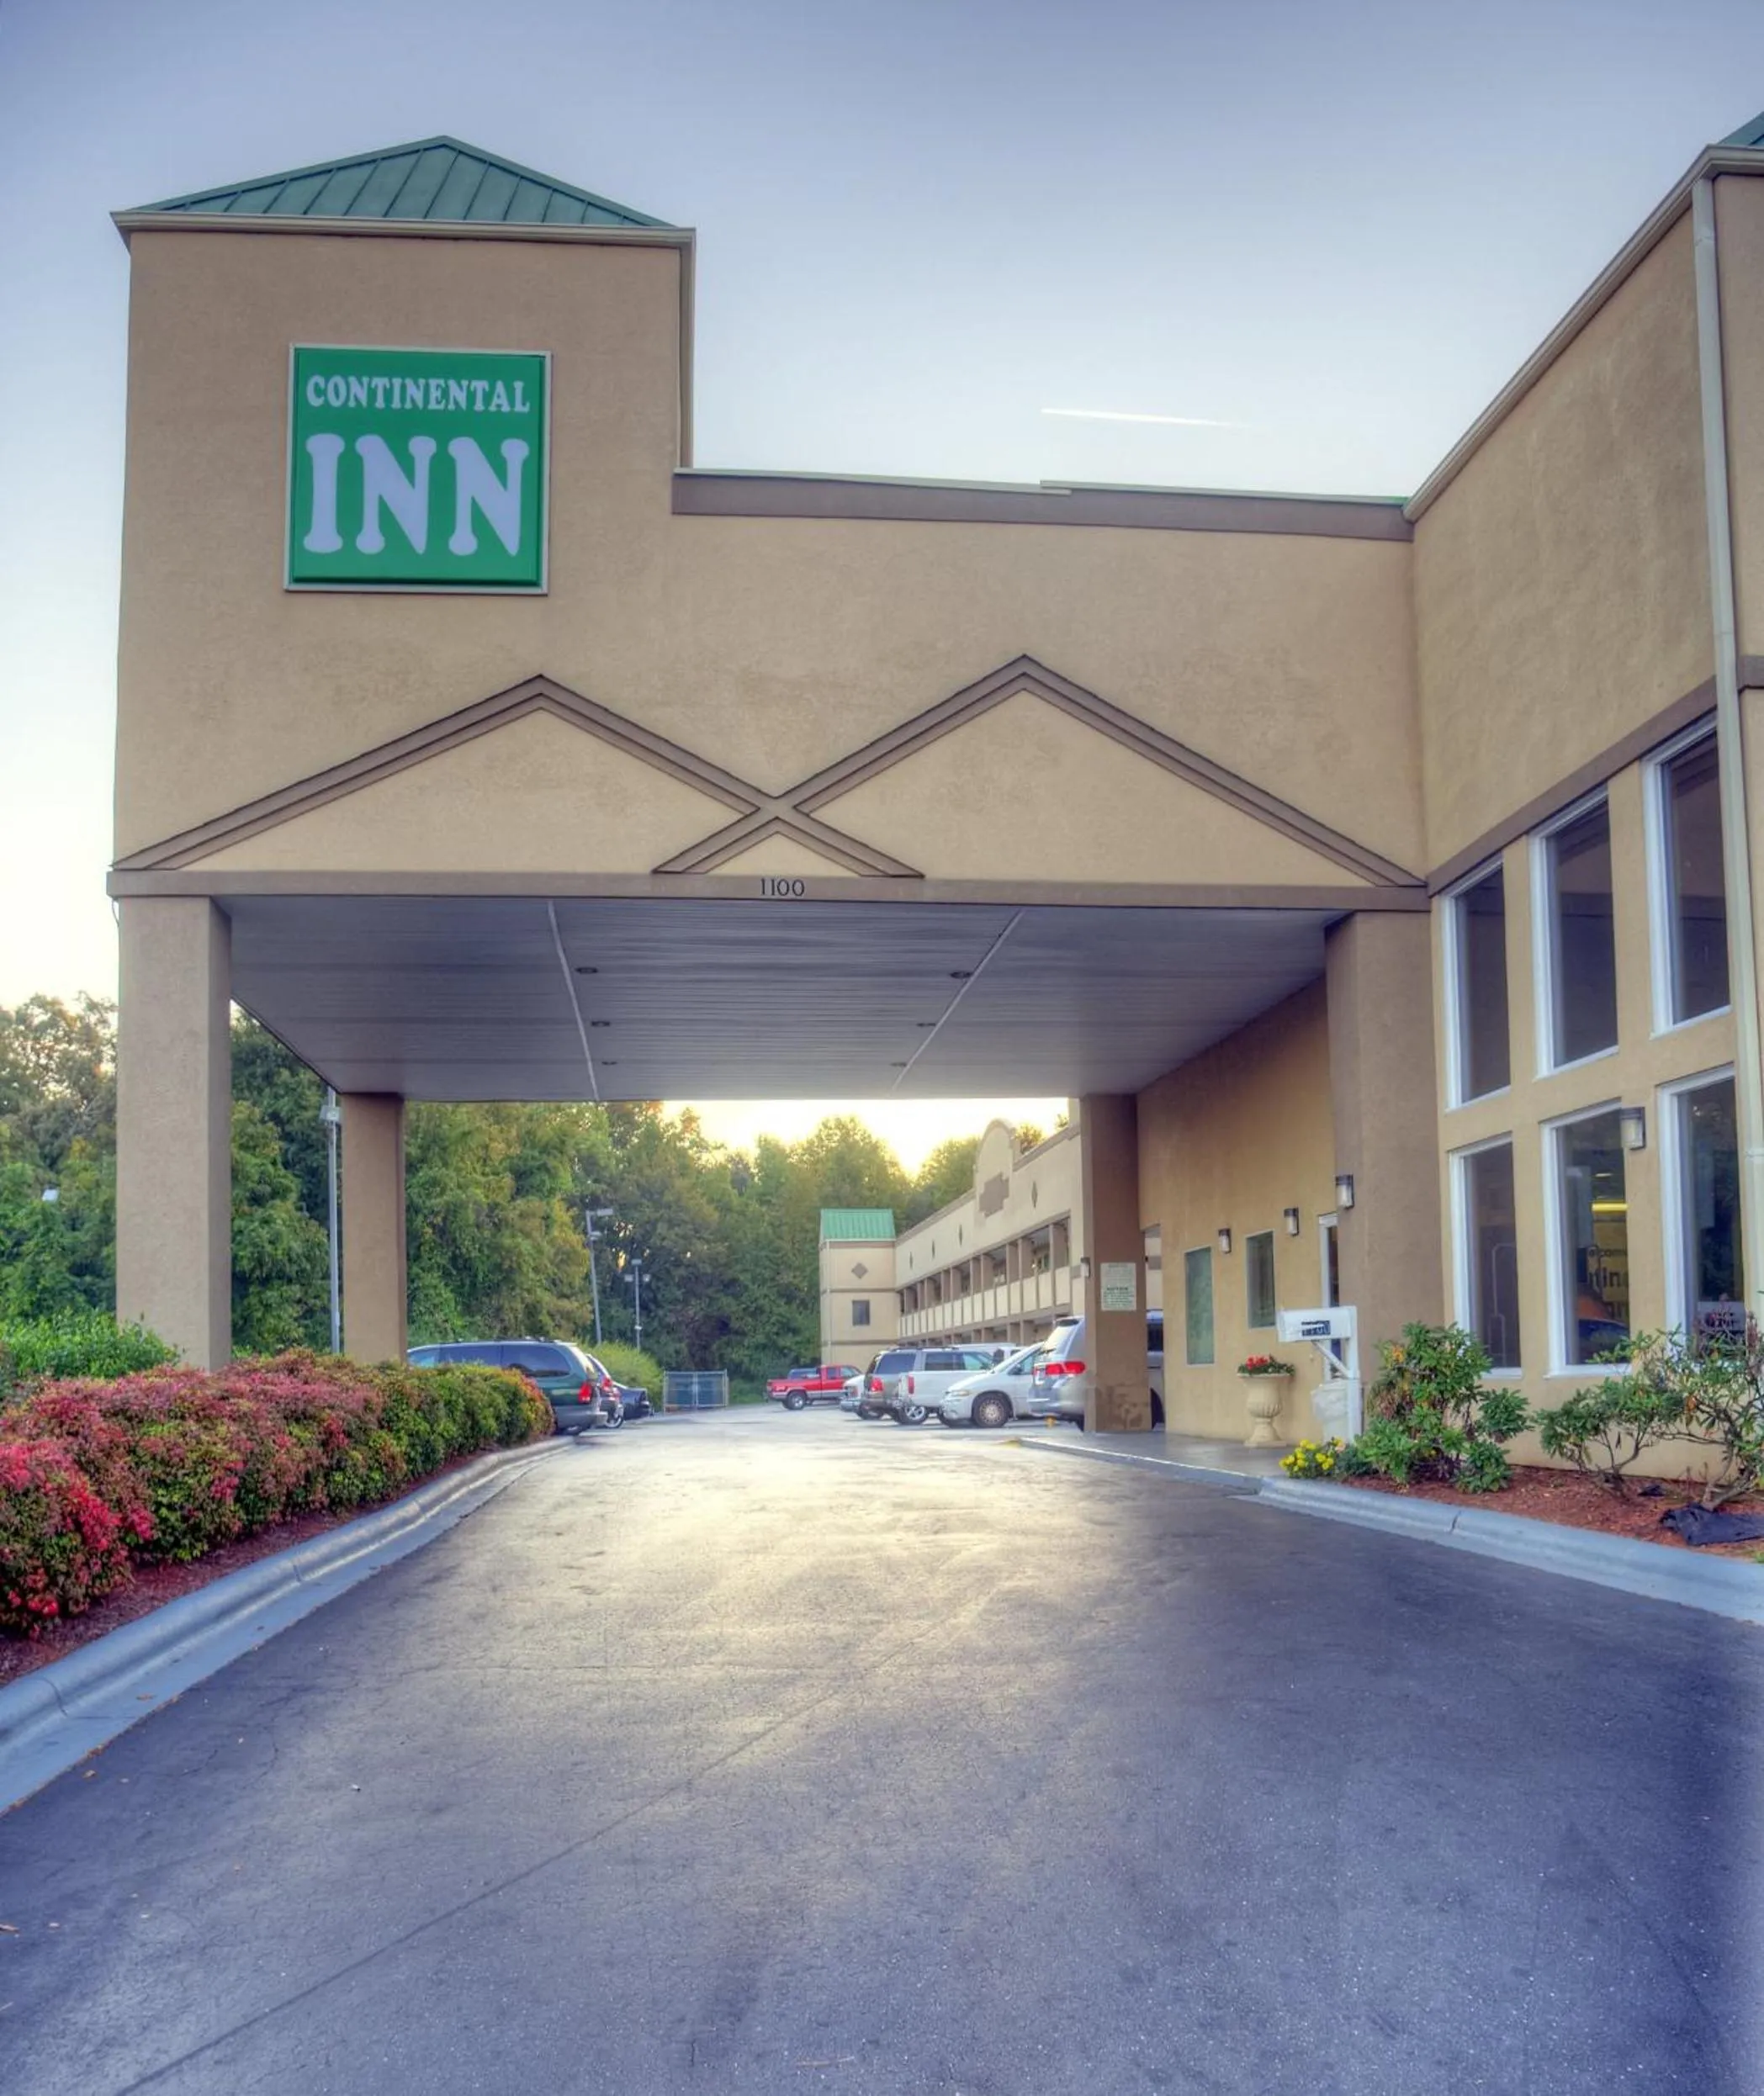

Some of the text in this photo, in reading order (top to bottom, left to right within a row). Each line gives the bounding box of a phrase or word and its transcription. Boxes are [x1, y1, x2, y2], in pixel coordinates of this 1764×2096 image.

[306, 375, 530, 412] CONTINENTAL
[304, 433, 530, 557] INN
[760, 878, 805, 897] 1100
